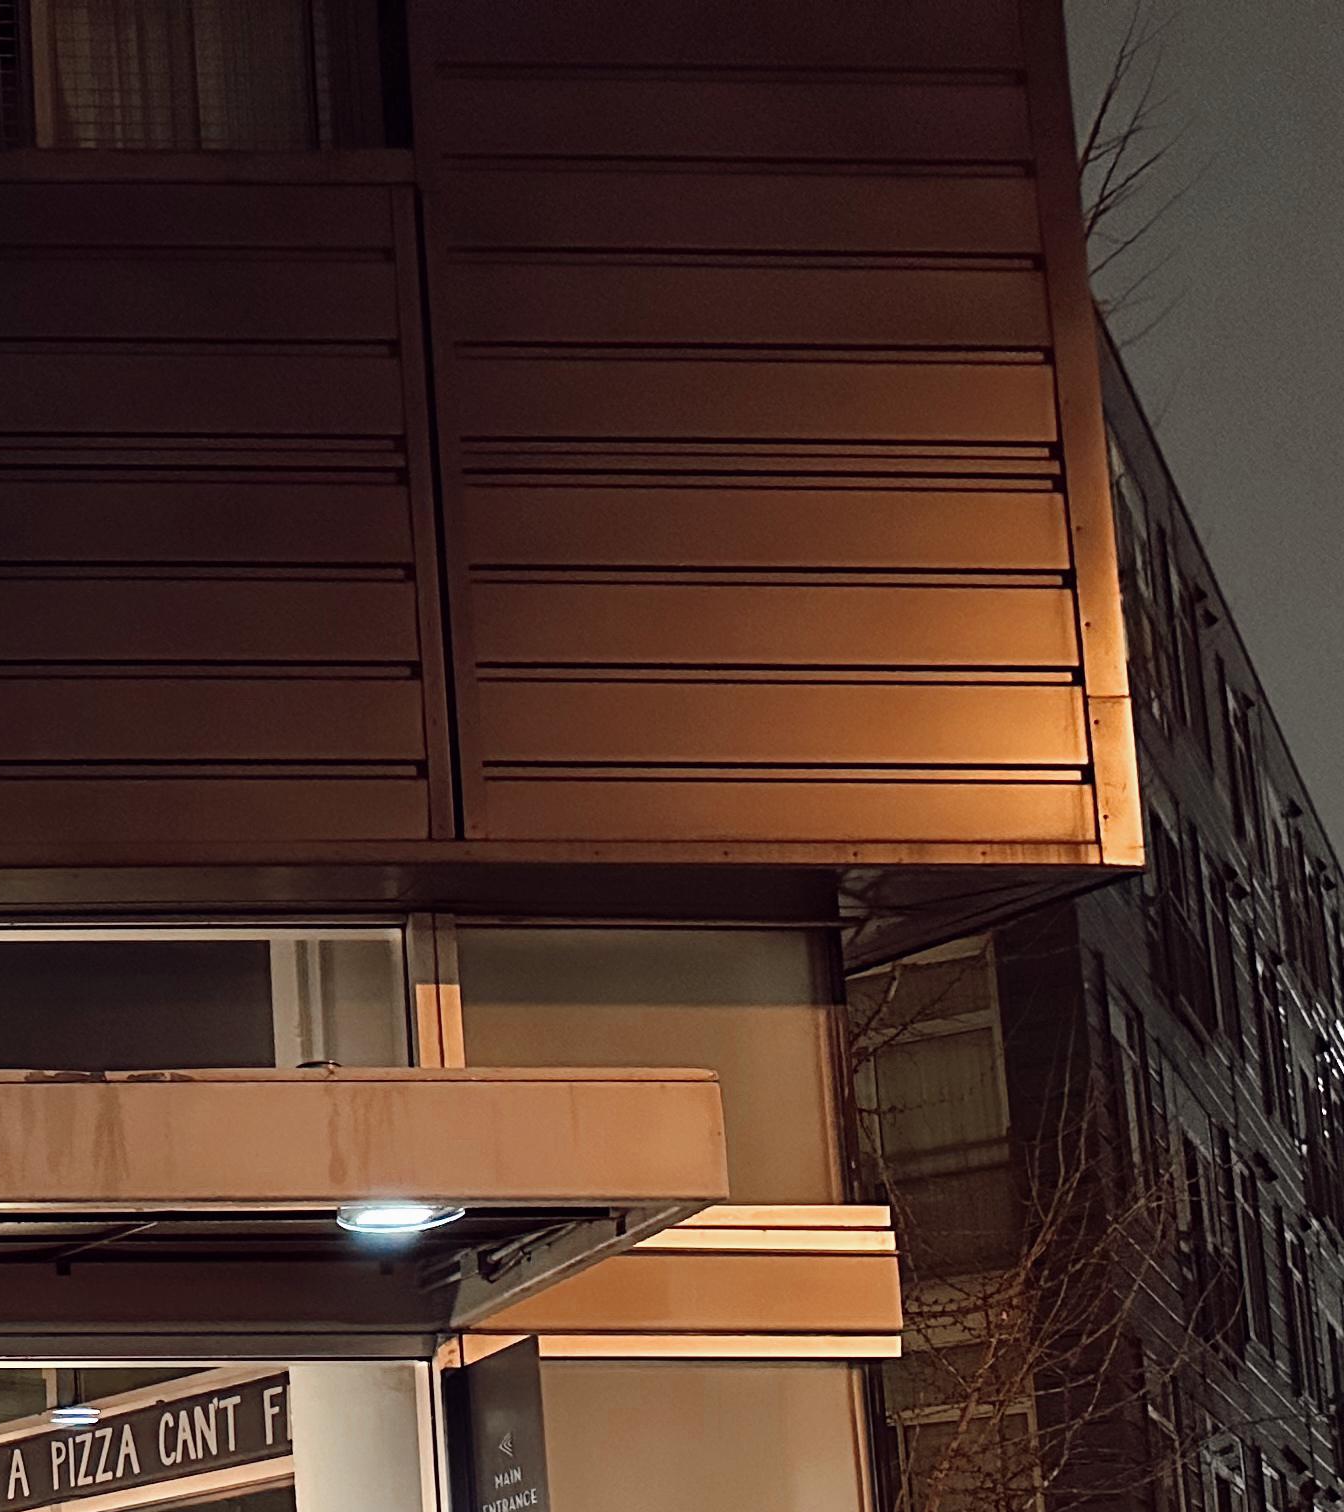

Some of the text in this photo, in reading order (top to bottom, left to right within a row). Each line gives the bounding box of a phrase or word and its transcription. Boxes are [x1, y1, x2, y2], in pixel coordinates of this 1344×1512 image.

[7, 1449, 30, 1499] A
[51, 1424, 140, 1490] PIZZA
[158, 1395, 240, 1467] CAN'T
[494, 1467, 522, 1489] MAIN
